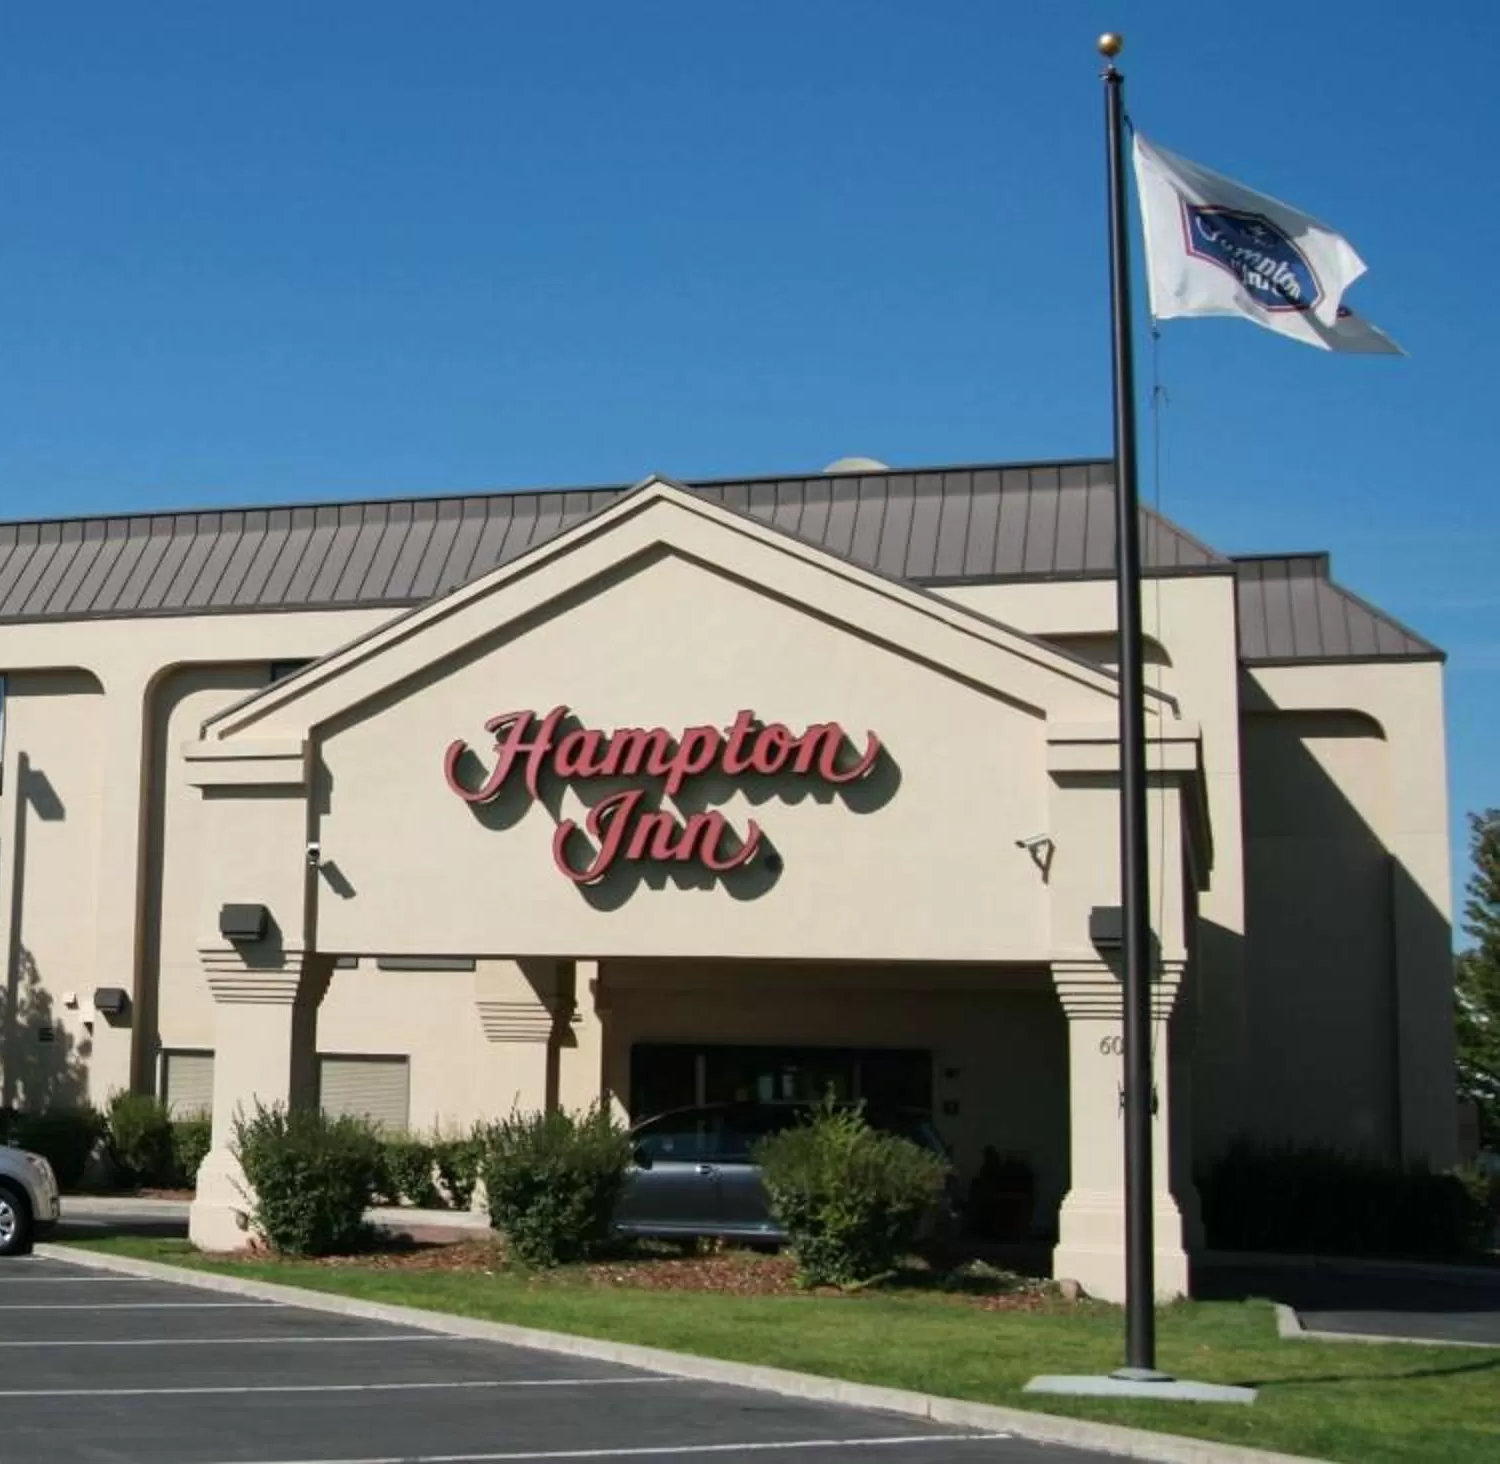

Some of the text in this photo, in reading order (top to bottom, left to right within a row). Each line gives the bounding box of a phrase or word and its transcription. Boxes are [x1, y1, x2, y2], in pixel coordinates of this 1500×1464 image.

[1194, 214, 1301, 300] mpton
[444, 705, 882, 801] Hampton
[552, 789, 763, 883] Inn
